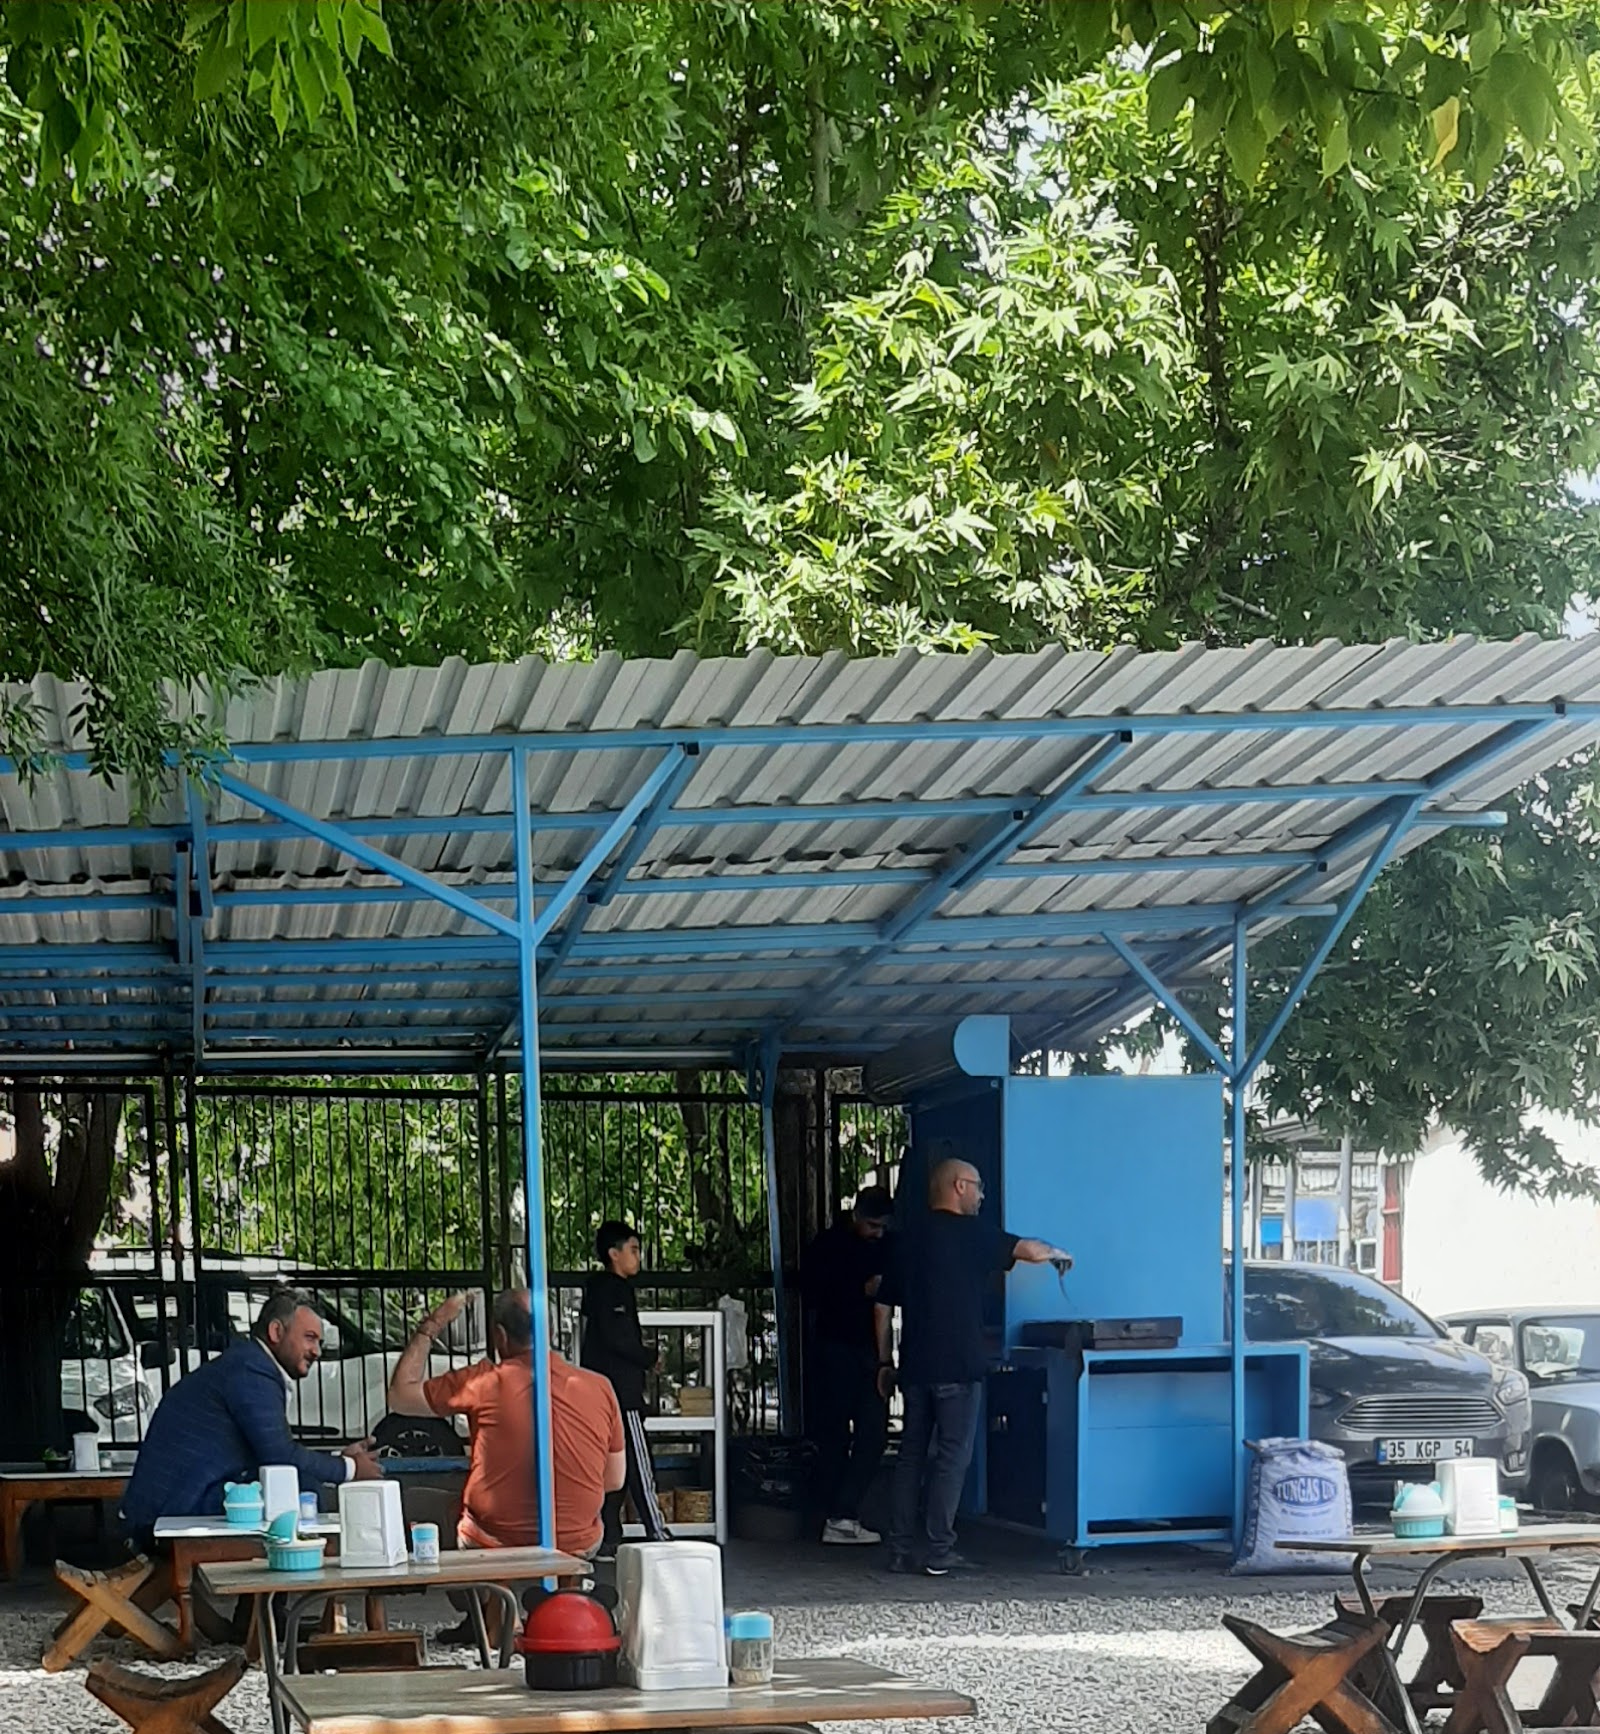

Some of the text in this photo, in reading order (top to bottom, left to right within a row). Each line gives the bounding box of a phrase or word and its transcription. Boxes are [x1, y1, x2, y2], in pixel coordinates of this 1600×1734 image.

[1389, 1440, 1470, 1458] 35 KGP 54
